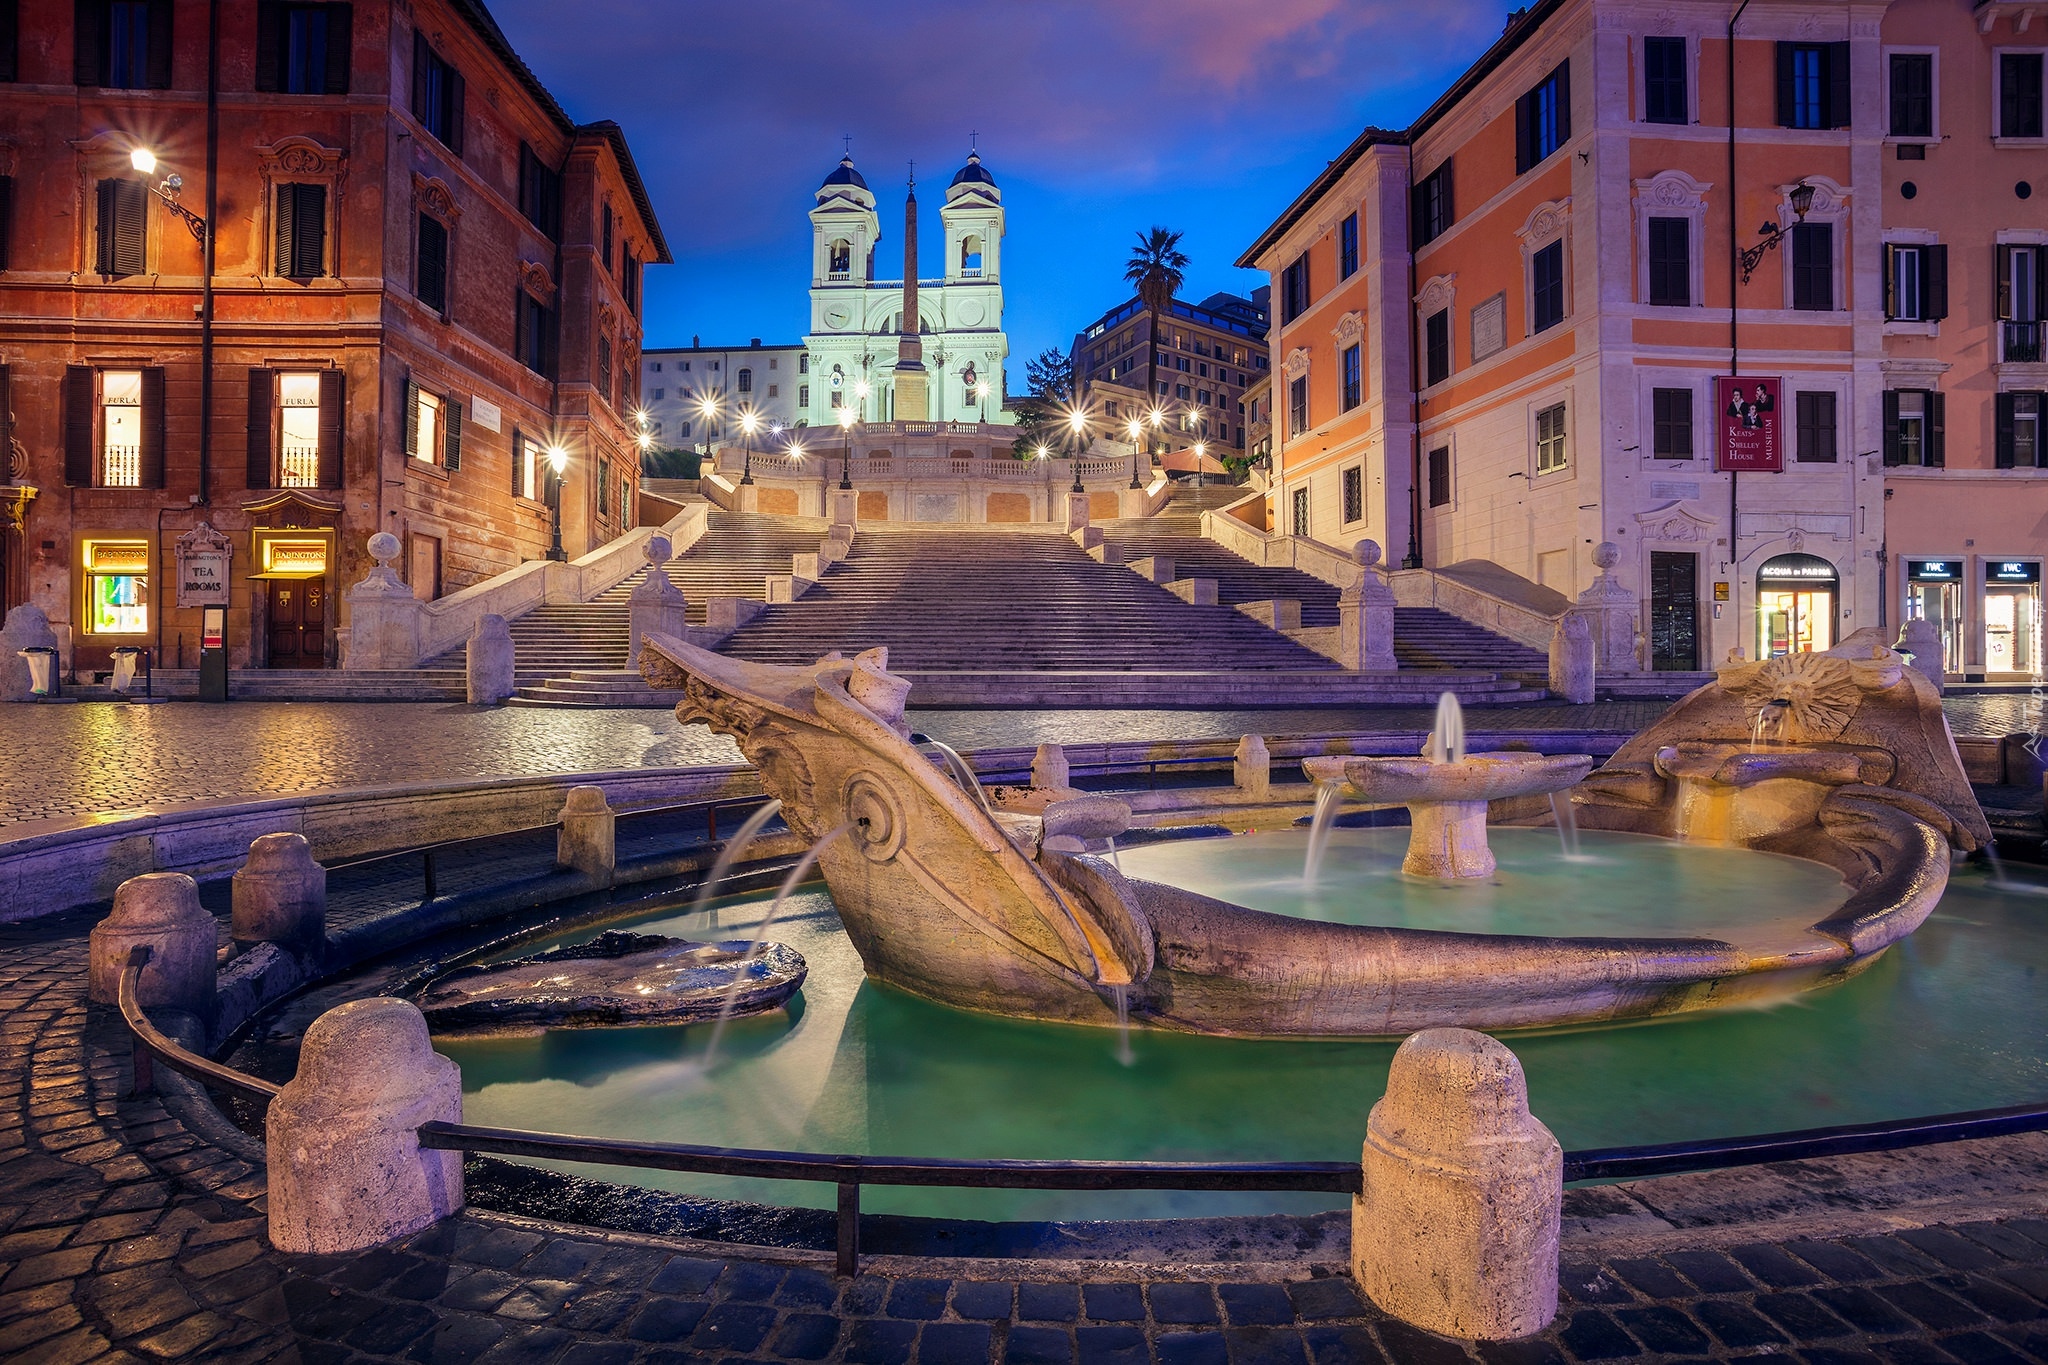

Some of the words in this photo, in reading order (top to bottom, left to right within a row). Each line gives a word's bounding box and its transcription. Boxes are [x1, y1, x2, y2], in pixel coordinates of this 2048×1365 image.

[1729, 438, 1760, 449] SHELLEY
[1765, 419, 1773, 460] MUSEUM
[1729, 450, 1754, 461] HOUSE
[192, 567, 214, 577] TEA
[1762, 567, 1792, 576] ACQUA
[1926, 562, 1945, 572] IWC
[2003, 563, 2022, 572] IWC
[185, 582, 222, 592] ROOMS
